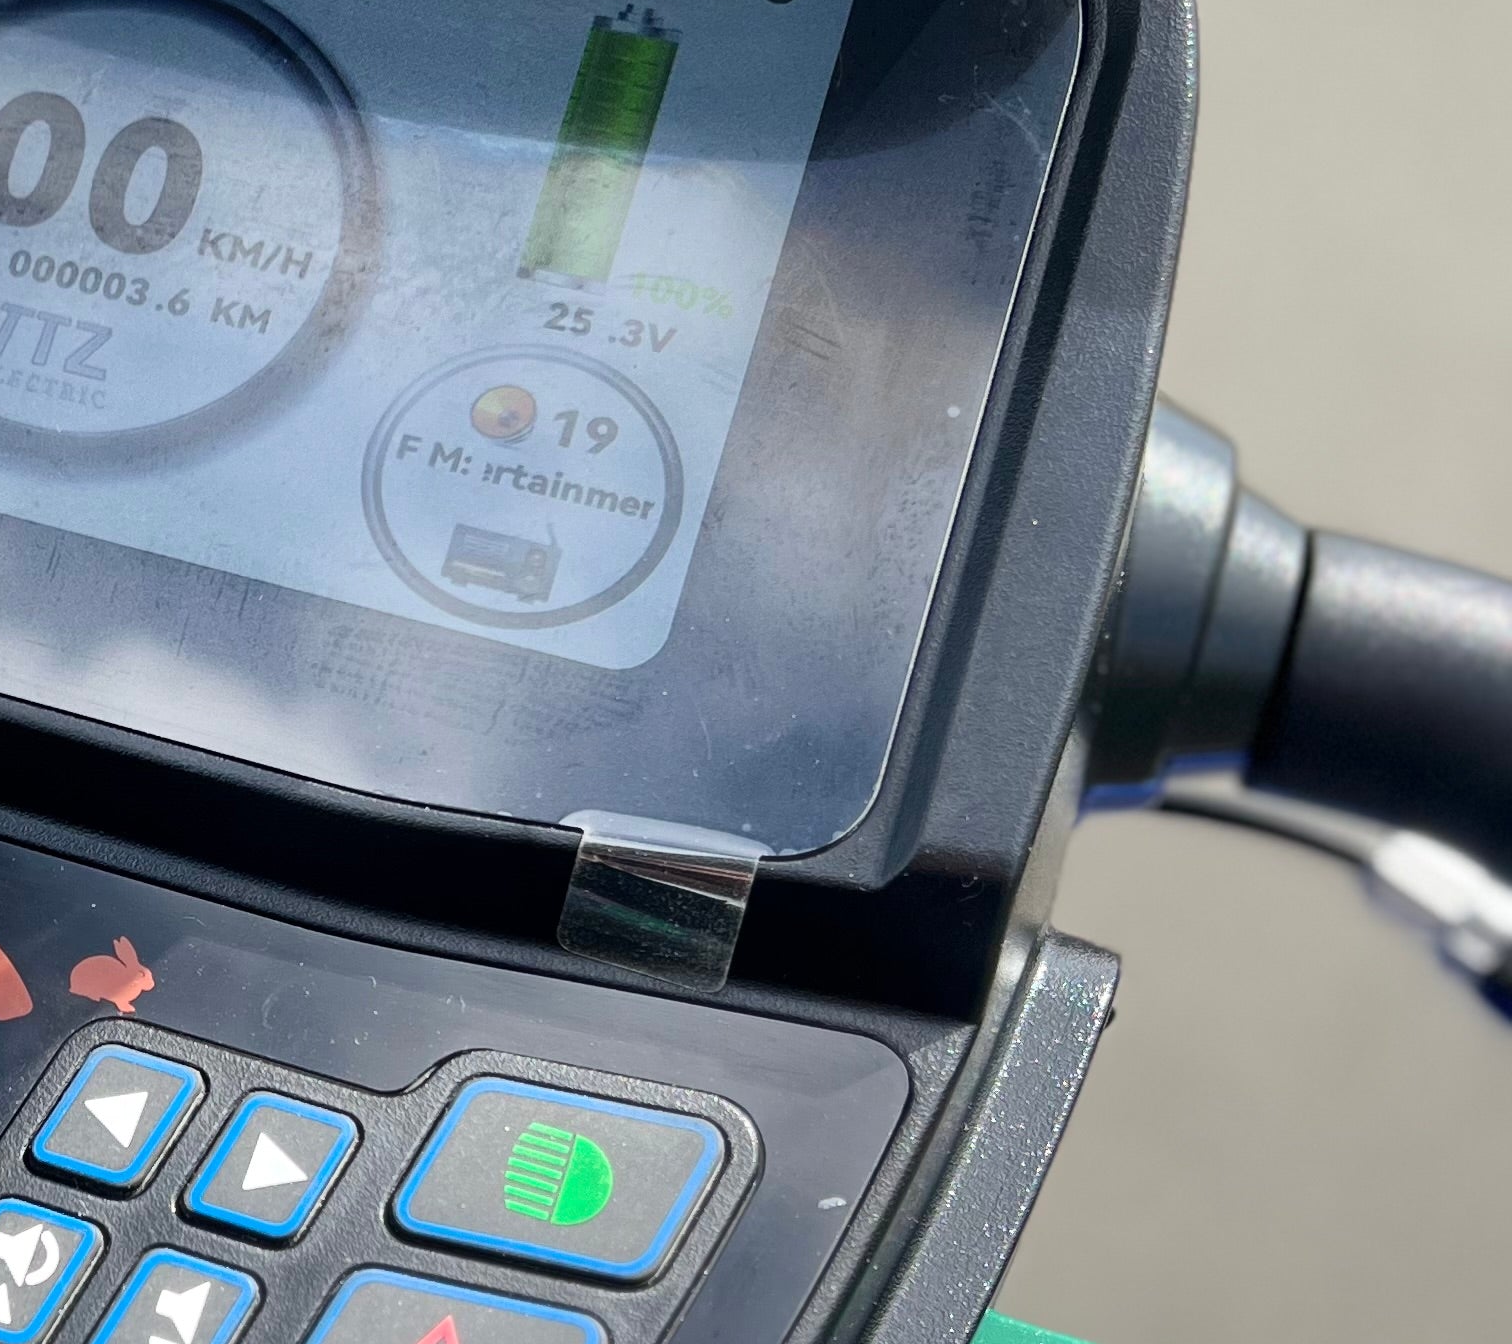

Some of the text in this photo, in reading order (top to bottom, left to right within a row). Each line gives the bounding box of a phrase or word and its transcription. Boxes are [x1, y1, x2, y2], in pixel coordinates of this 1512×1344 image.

[197, 228, 313, 280] KM/H
[210, 296, 273, 335] KM
[632, 271, 734, 320] 100%
[553, 409, 619, 455] 19
